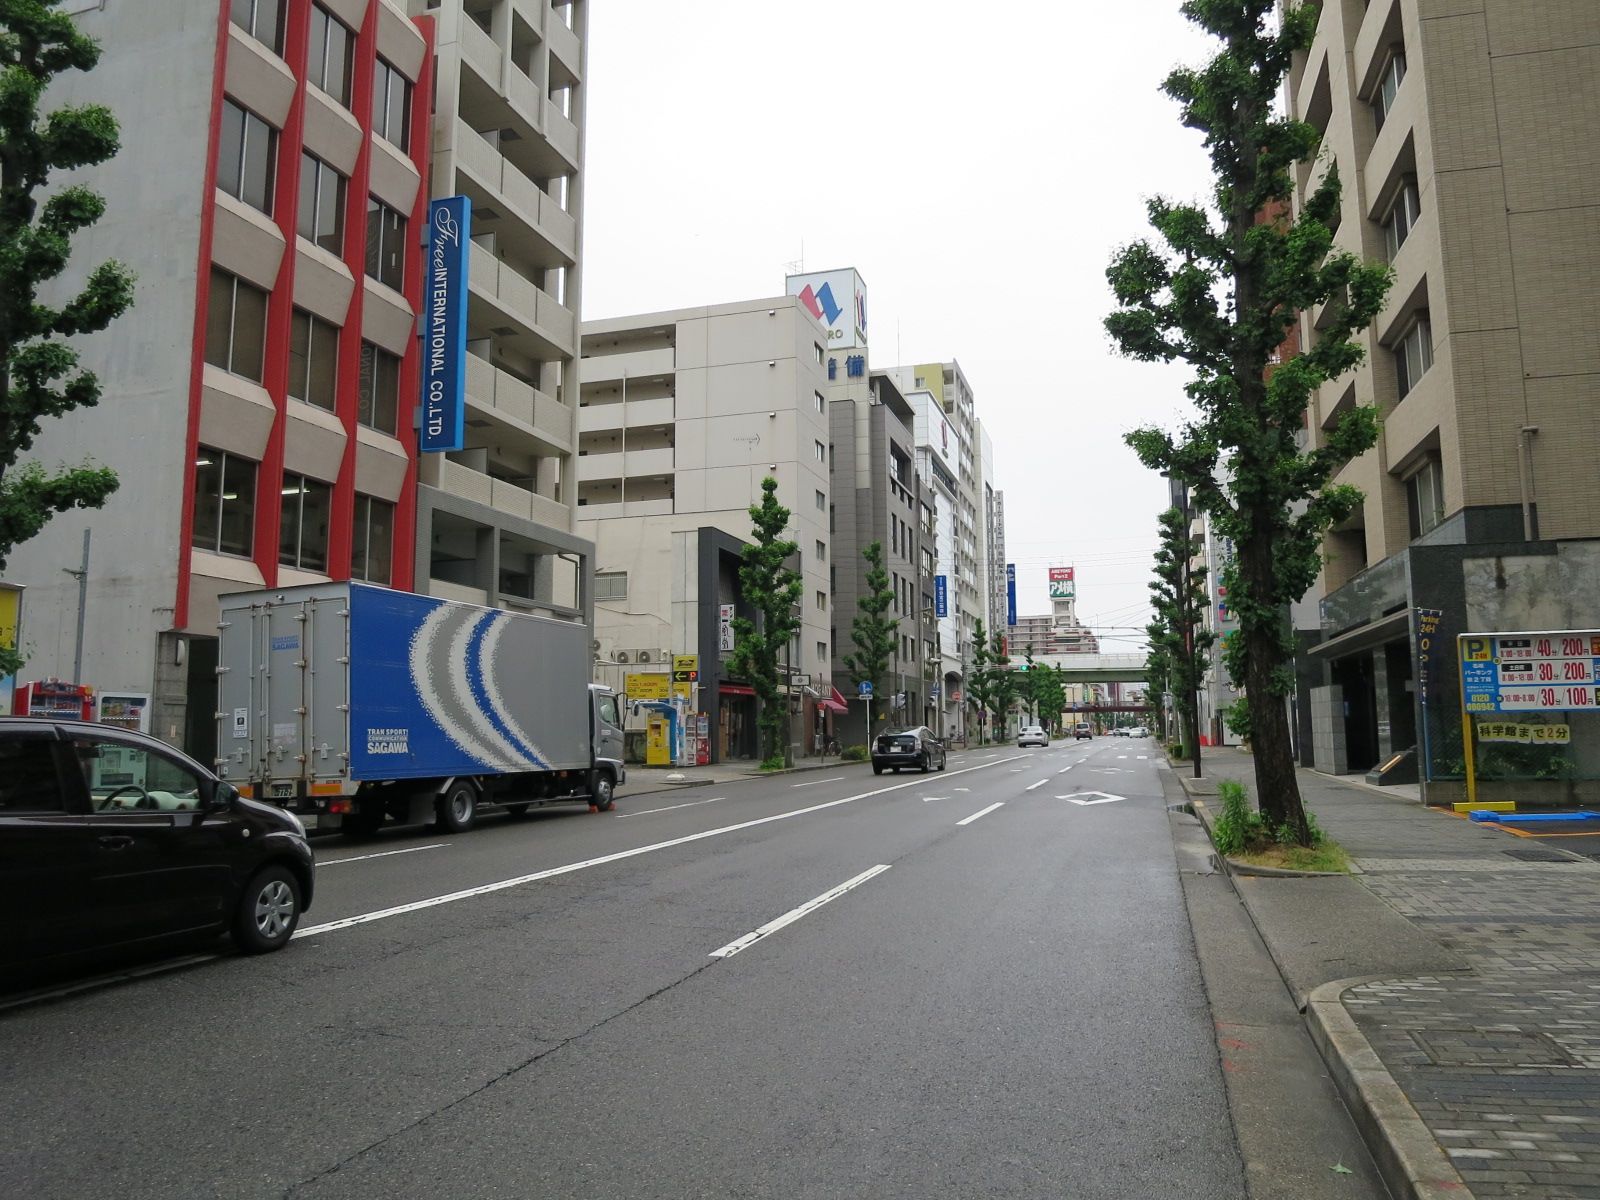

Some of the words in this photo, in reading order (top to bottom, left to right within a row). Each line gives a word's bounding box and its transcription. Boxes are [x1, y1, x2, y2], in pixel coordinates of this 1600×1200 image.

[428, 379, 444, 440] CO.,LTD.
[1050, 581, 1073, 595] アメ横
[1468, 640, 1484, 659] P
[1479, 725, 1568, 739] 科学館まで2分
[367, 742, 409, 754] SAGAWA
